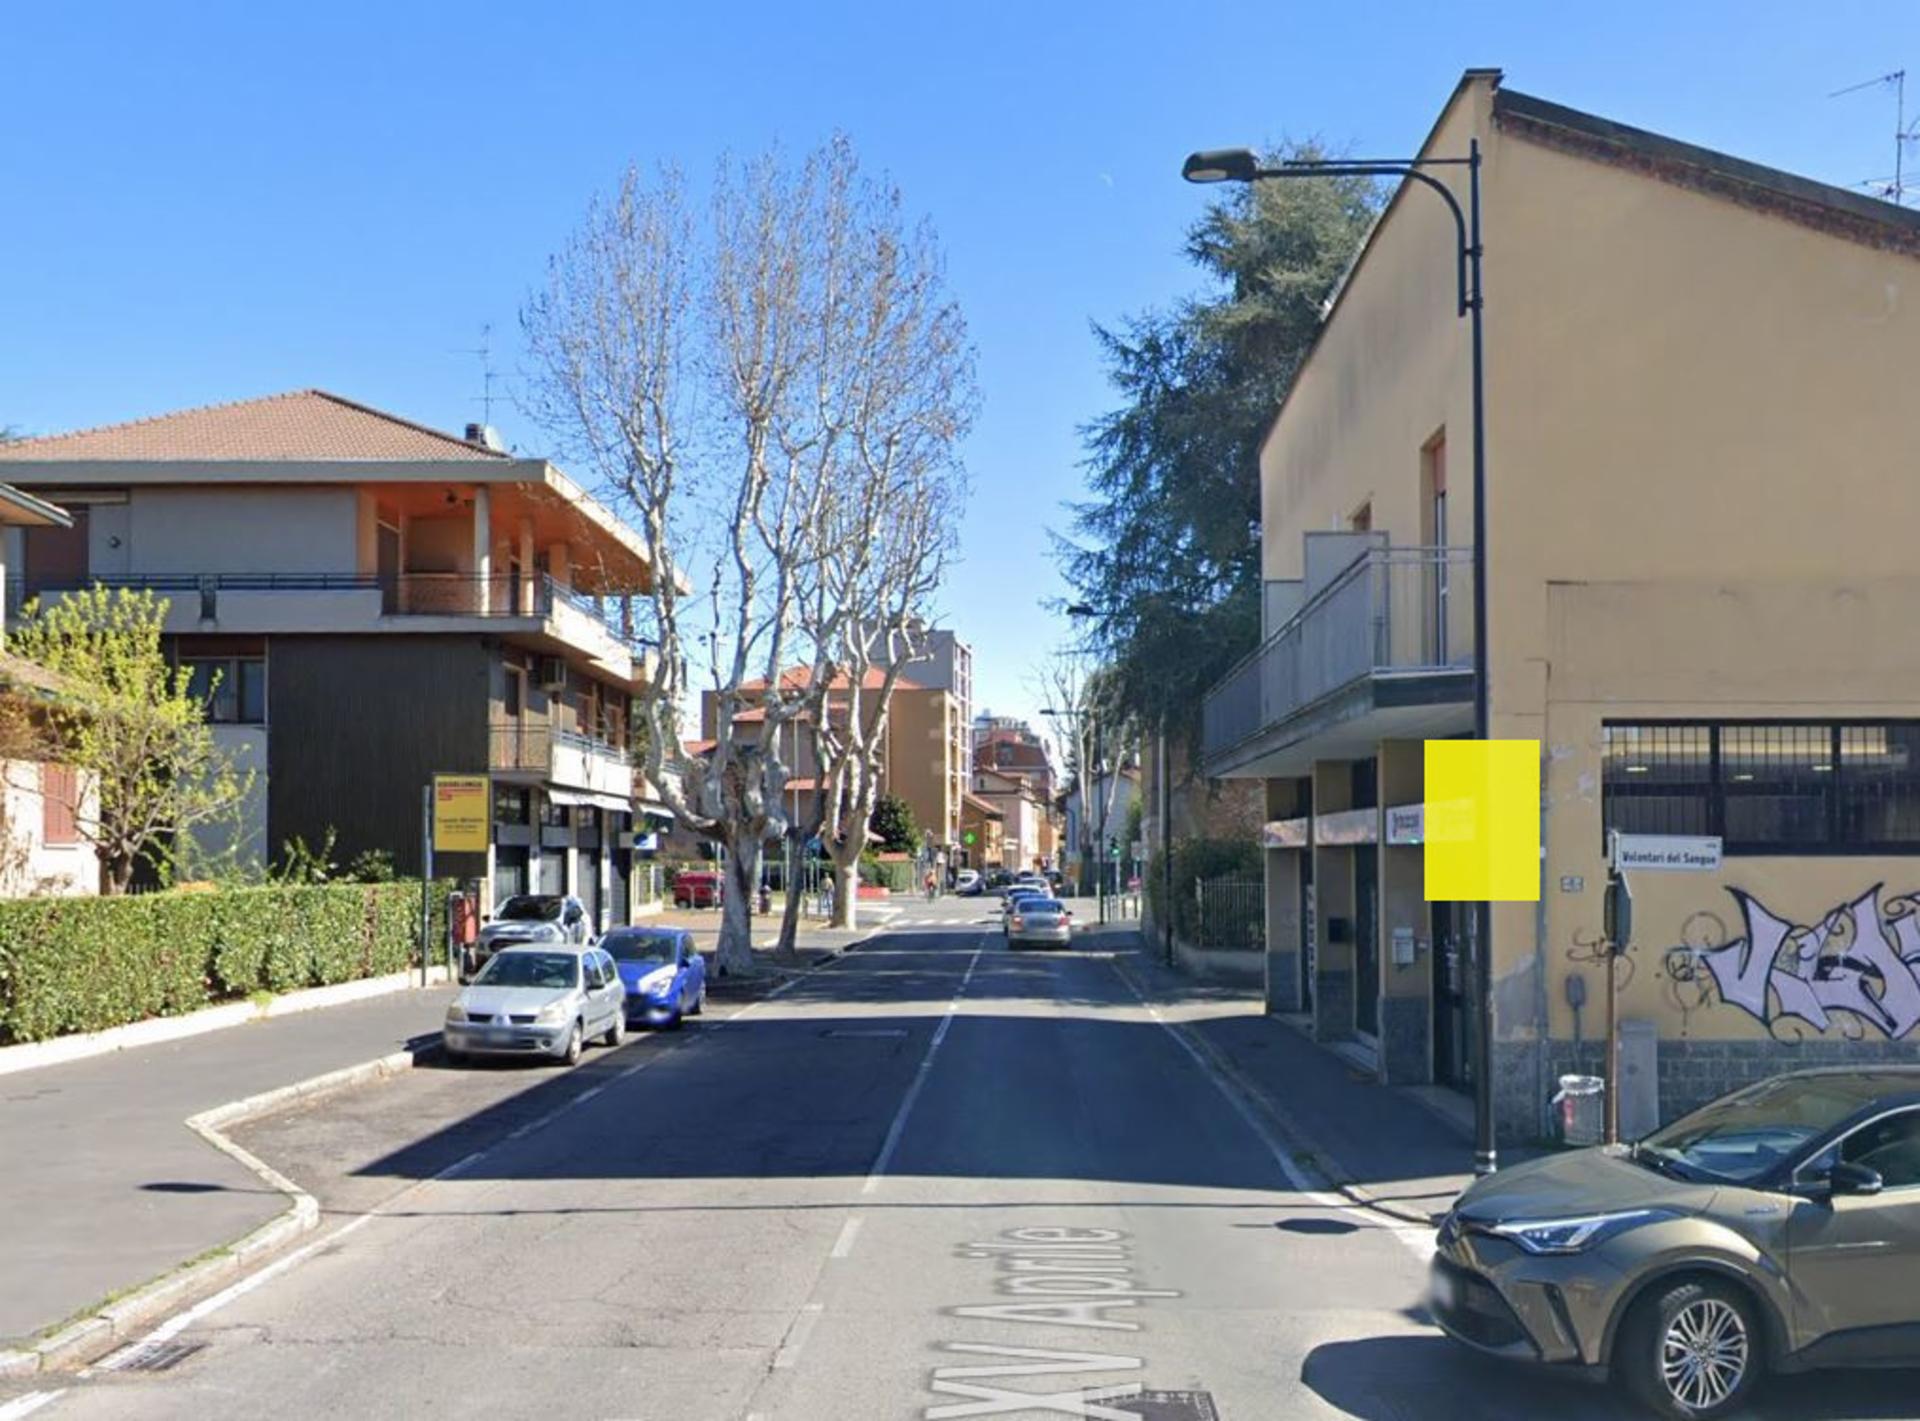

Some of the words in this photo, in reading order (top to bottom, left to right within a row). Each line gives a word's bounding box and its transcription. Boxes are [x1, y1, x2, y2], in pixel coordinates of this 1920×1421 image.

[1622, 850, 1665, 864] Volontari
[1666, 851, 1681, 864] del
[1684, 852, 1716, 867] Sangue
